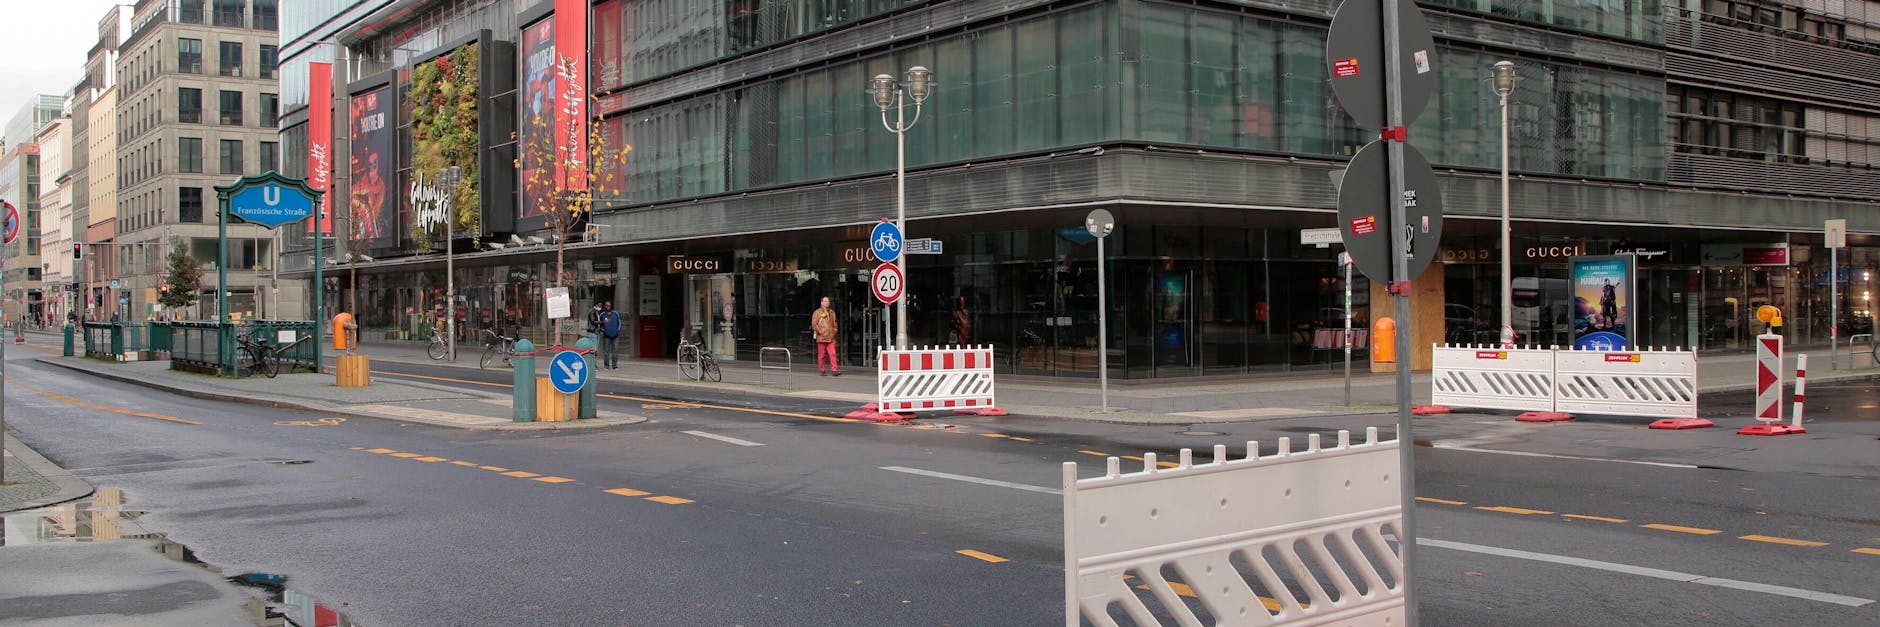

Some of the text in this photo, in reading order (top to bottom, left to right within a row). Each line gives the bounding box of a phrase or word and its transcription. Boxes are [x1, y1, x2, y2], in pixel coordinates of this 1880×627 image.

[263, 186, 280, 206] U
[238, 207, 306, 216] Französische Straße
[845, 247, 875, 262] GUC
[1526, 246, 1578, 258] GUCCI
[673, 260, 719, 270] GUCCI
[880, 275, 897, 291] 20
